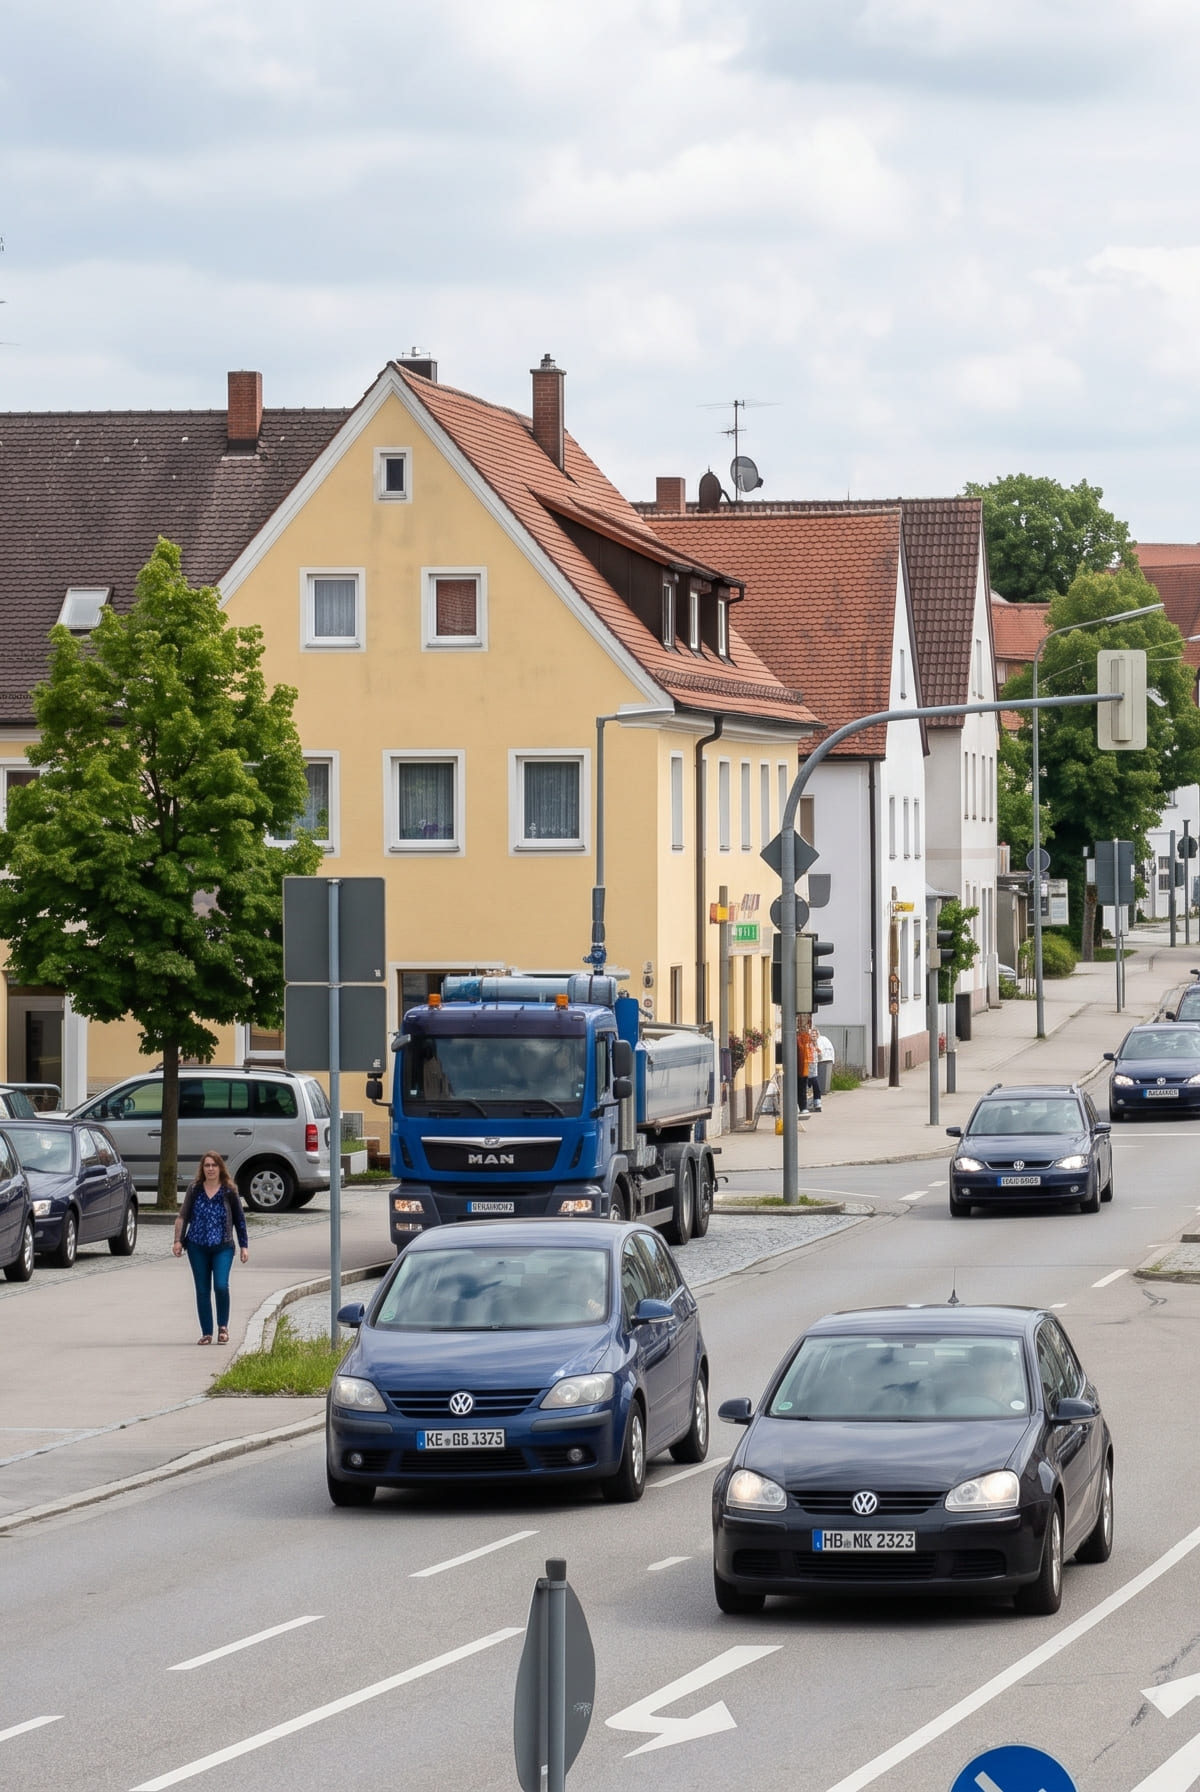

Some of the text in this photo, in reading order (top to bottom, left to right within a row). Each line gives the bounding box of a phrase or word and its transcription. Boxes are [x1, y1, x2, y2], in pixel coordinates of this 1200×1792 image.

[467, 1154, 515, 1165] MAN
[426, 1432, 443, 1447] KE
[823, 1532, 843, 1548] HB
[876, 1533, 914, 1549] 2323
